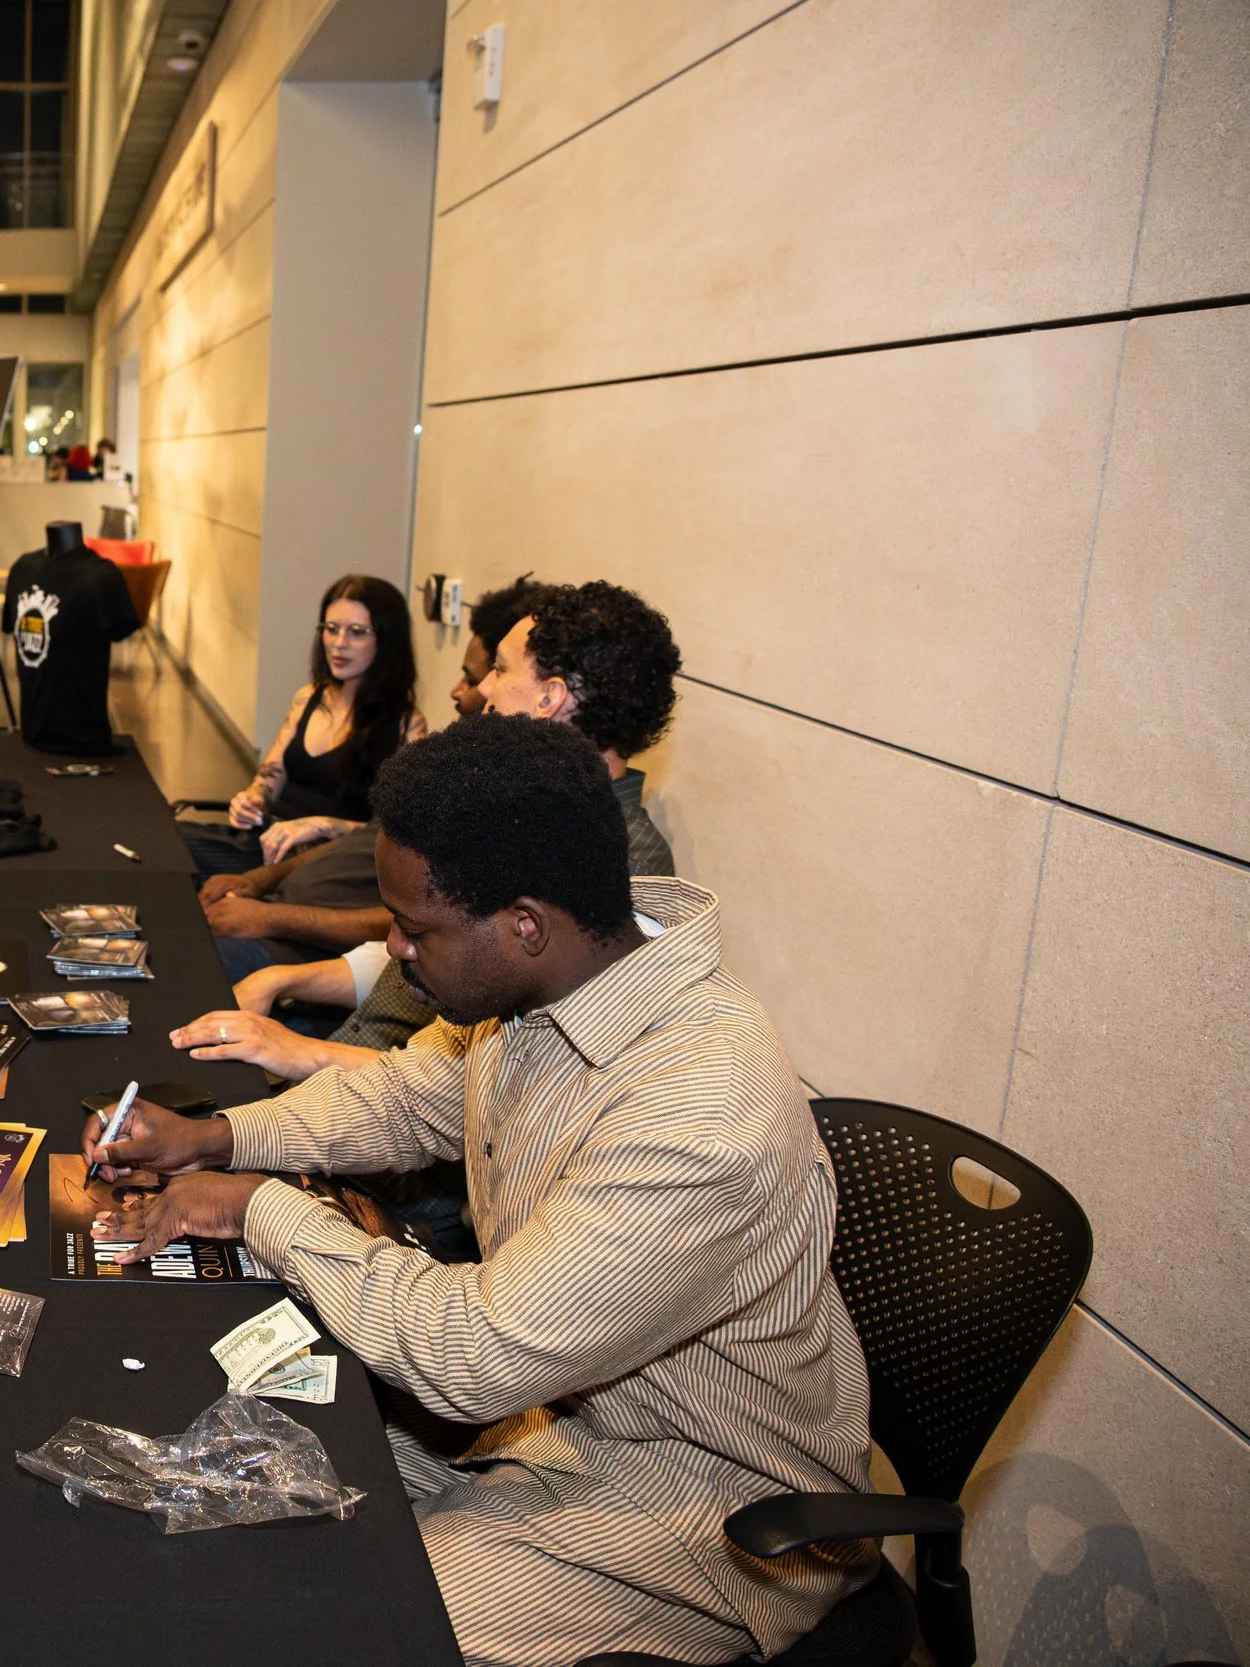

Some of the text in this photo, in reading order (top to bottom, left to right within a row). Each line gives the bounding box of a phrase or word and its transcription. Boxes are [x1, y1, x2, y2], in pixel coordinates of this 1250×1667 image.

[66, 1232, 74, 1245] JAZZ
[67, 1245, 75, 1255] FOR
[67, 1256, 75, 1270] TRIBE
[96, 1263, 123, 1276] THE
